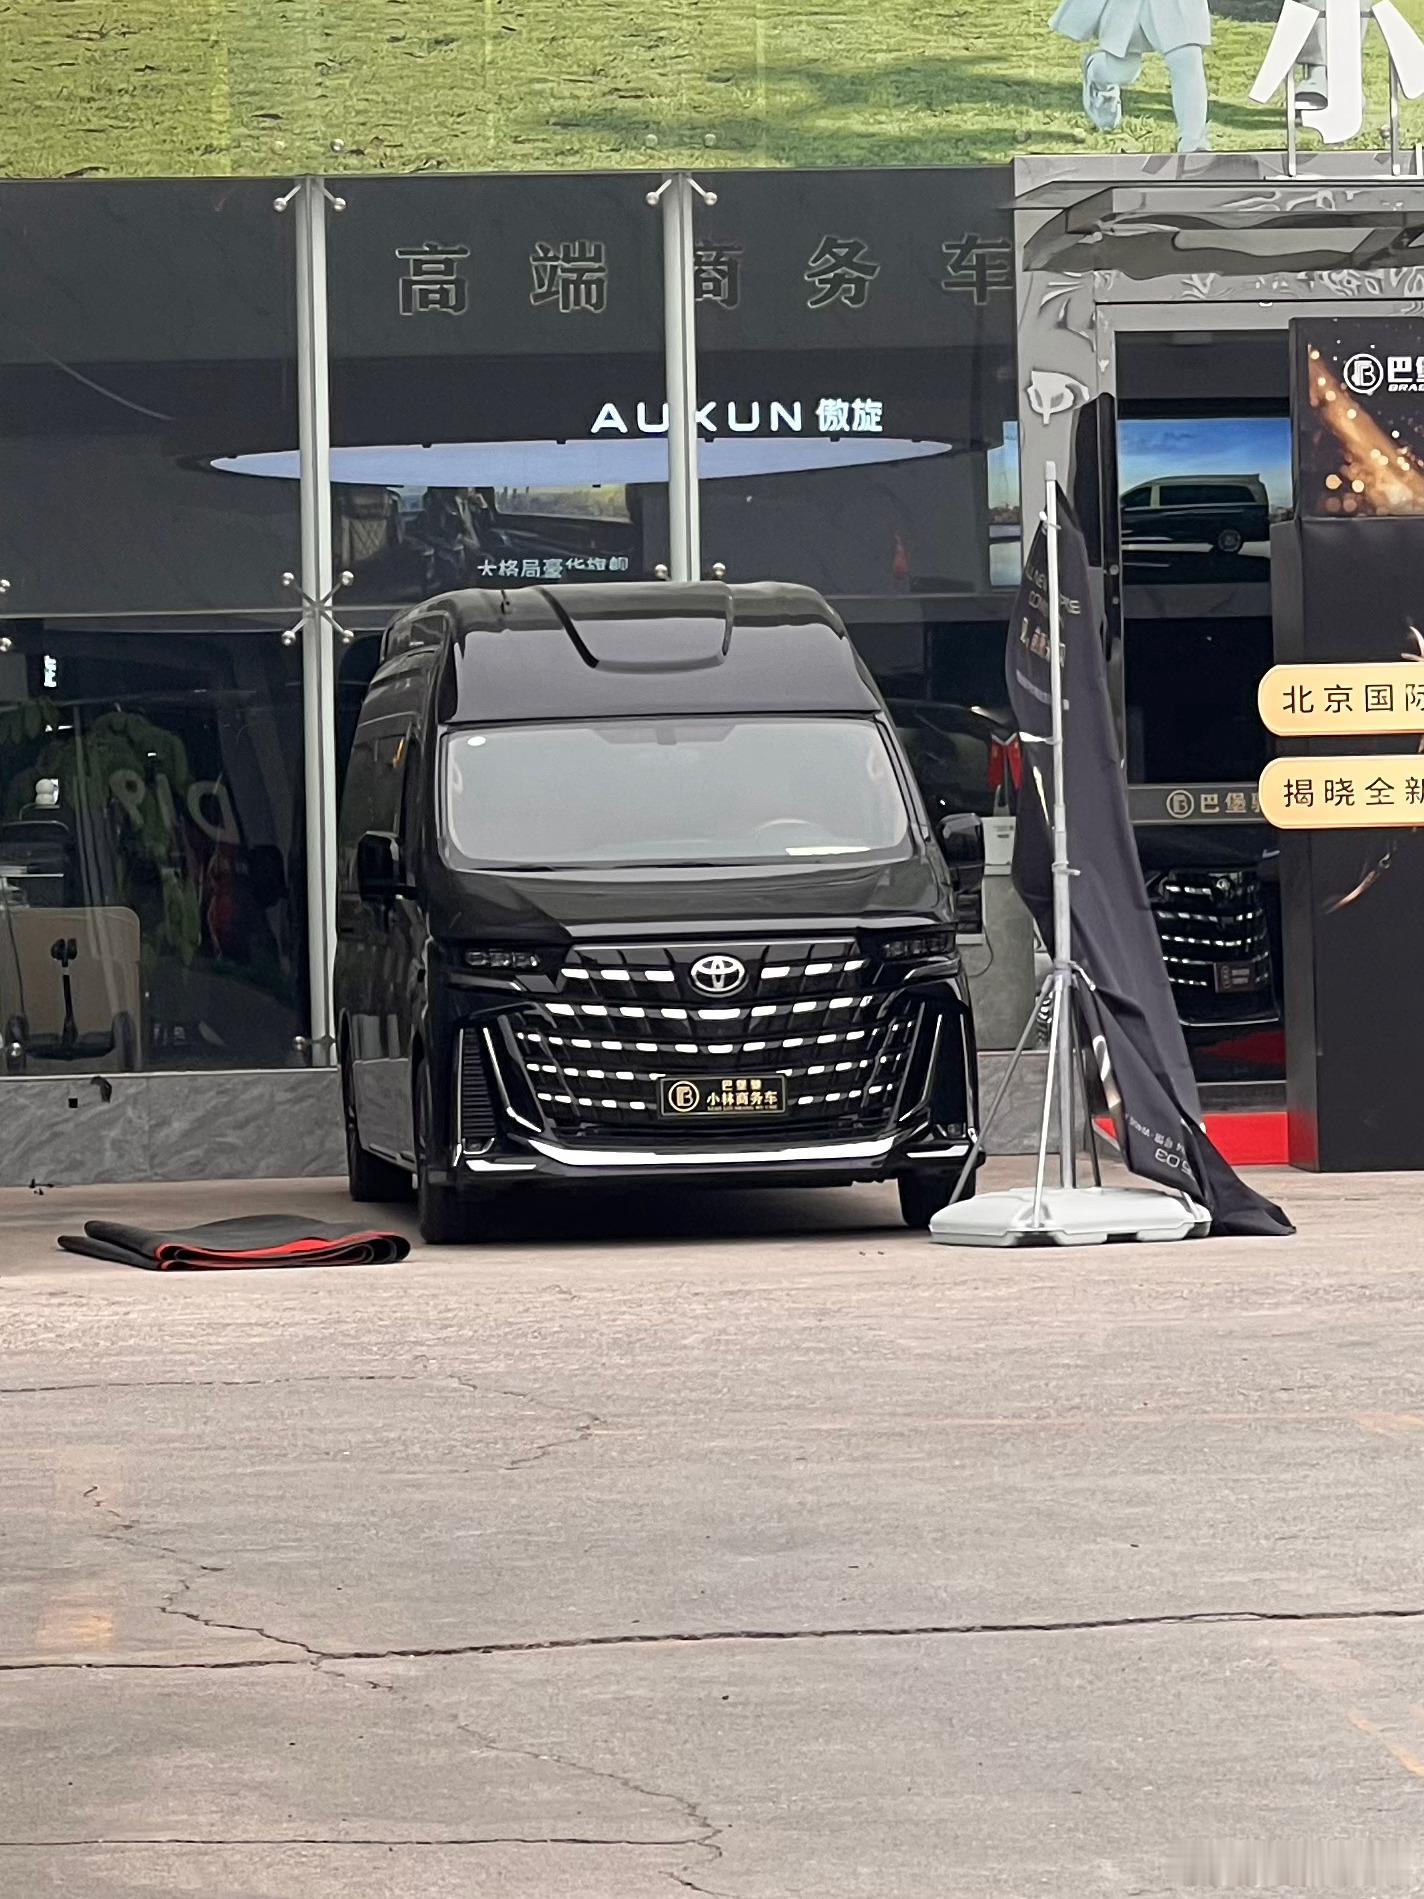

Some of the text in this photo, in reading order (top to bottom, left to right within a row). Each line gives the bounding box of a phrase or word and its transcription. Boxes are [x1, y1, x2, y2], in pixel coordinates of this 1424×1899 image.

[1248, 0, 1424, 144] 小
[395, 232, 1014, 316] 高端商务车
[816, 397, 884, 432] 傲旋
